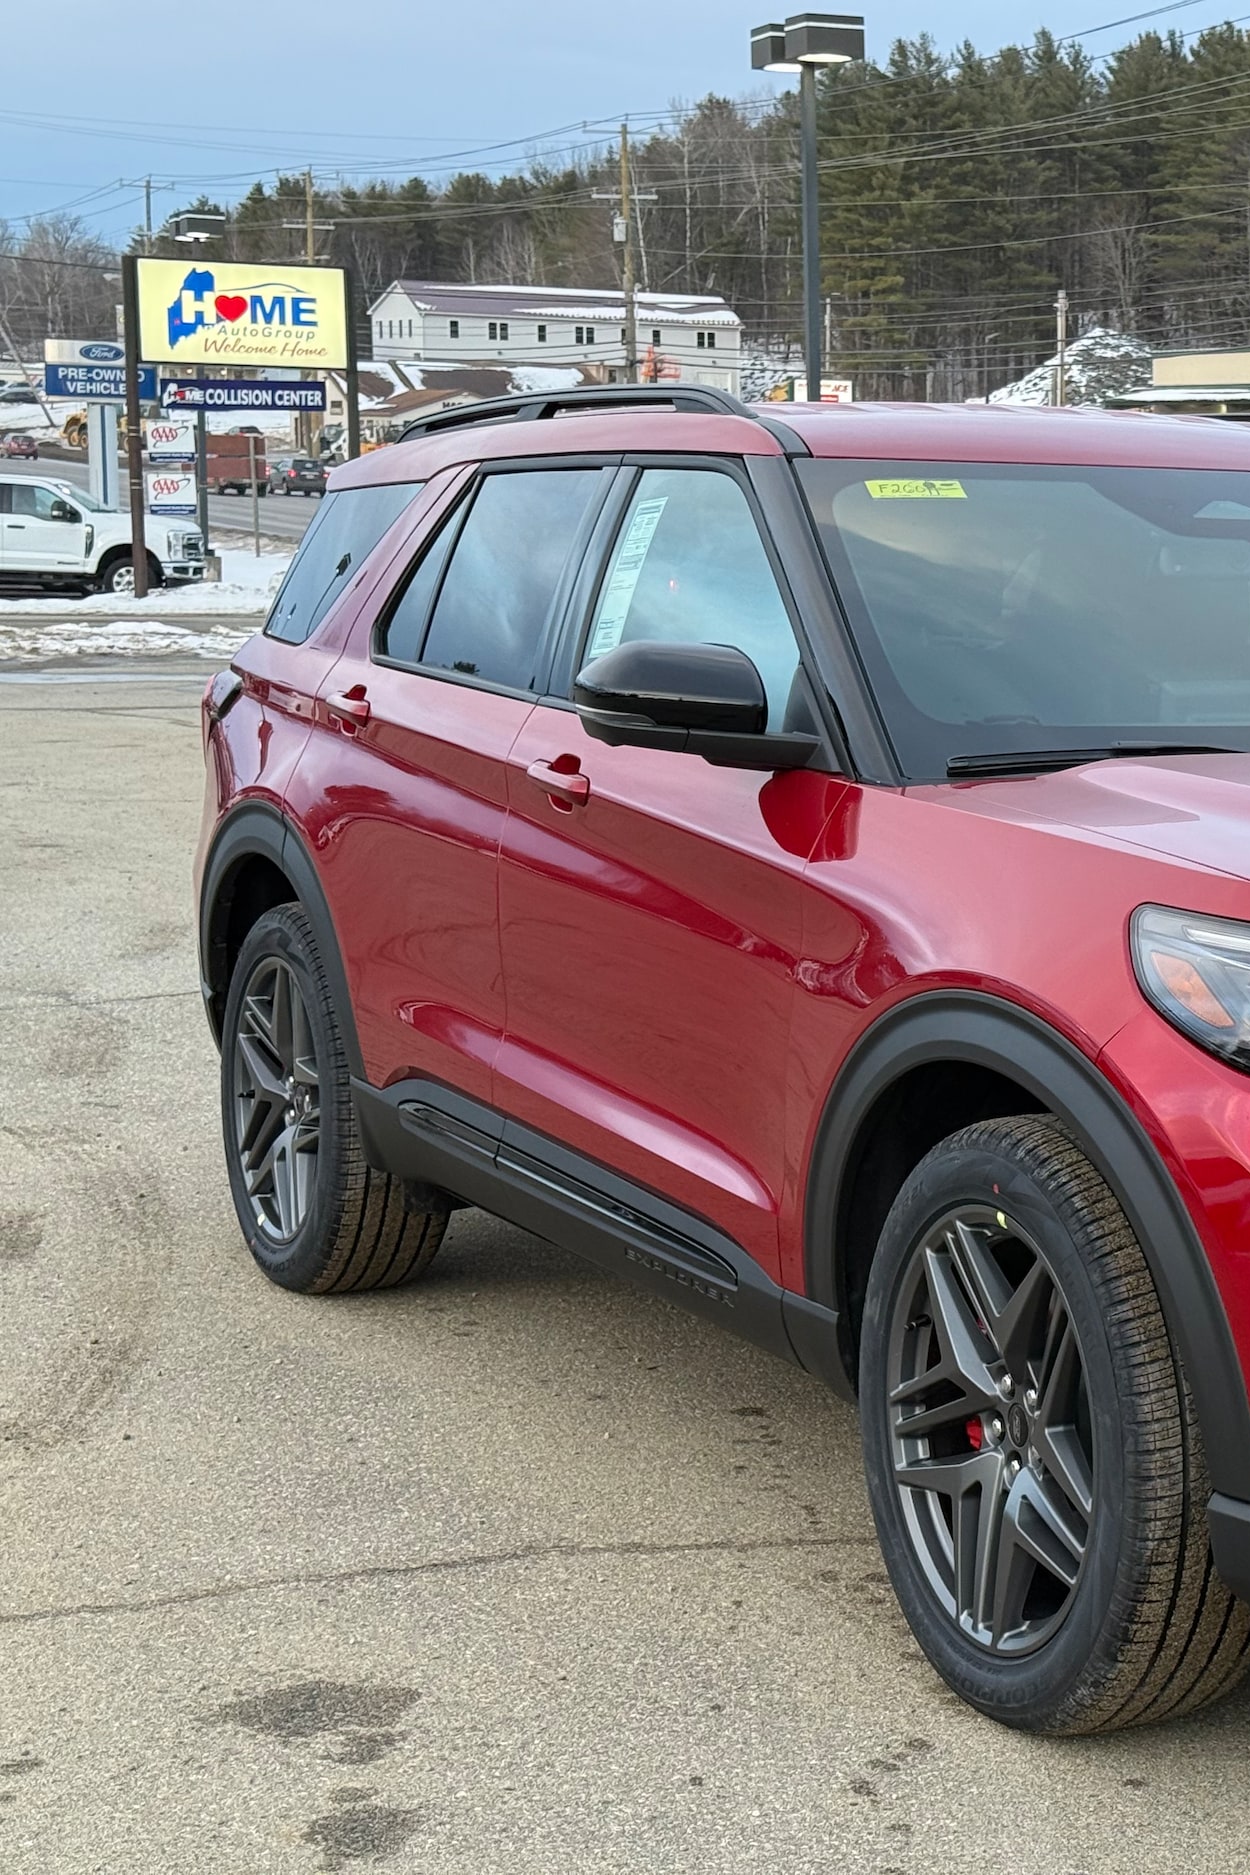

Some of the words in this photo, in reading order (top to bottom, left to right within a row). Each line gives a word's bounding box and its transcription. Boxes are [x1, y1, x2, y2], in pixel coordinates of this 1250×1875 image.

[203, 337, 278, 355] Welcome
[280, 341, 328, 357] Home
[58, 367, 145, 383] PRE-OWND
[205, 388, 272, 406] COLLISION
[274, 390, 323, 407] CENTER
[152, 426, 178, 442] AAA
[153, 479, 180, 495] AAA
